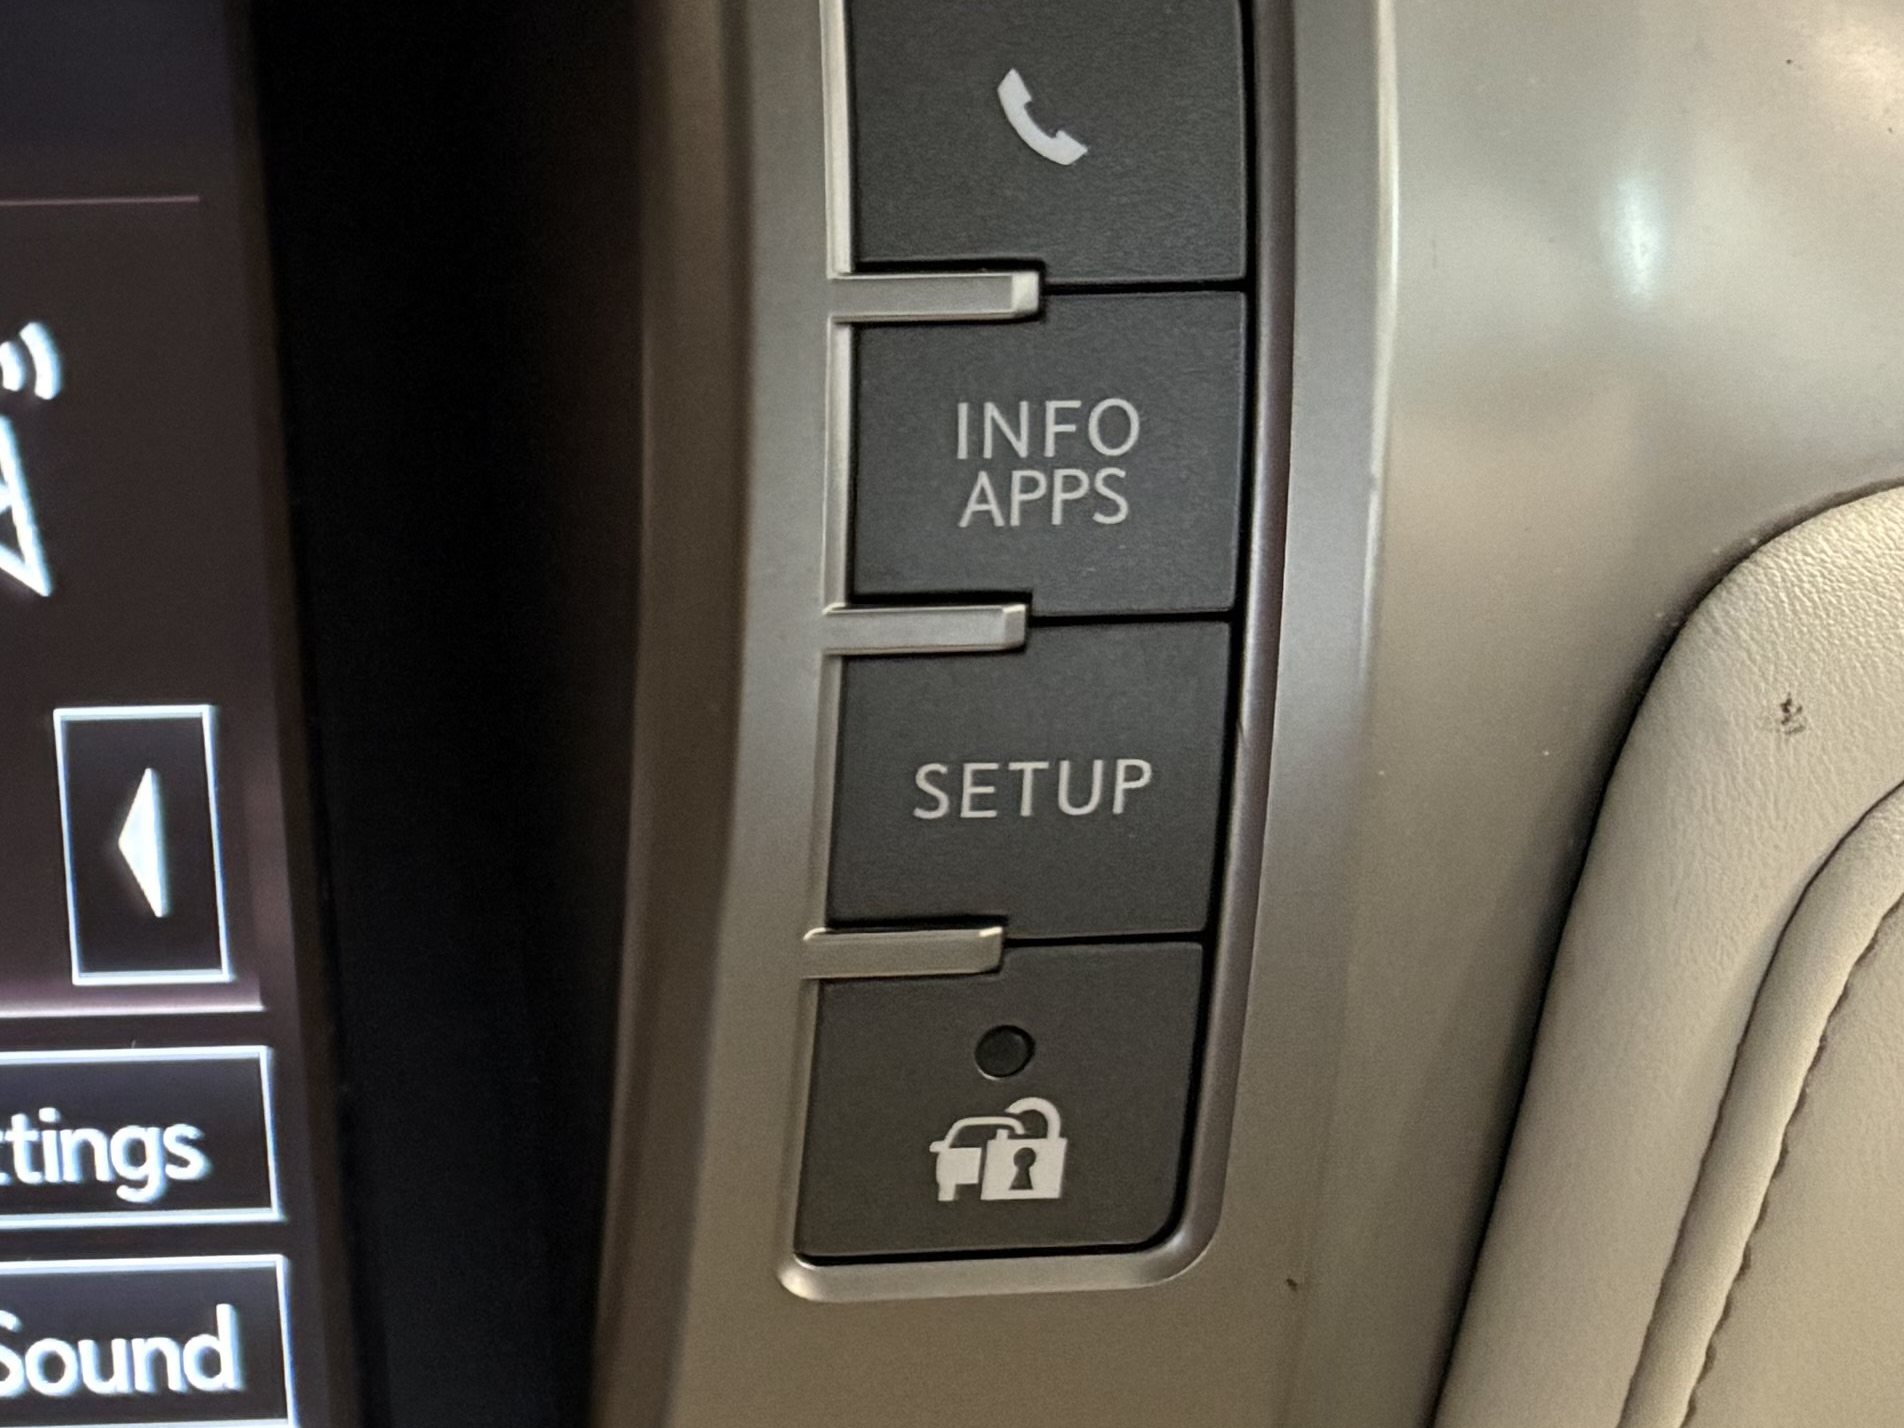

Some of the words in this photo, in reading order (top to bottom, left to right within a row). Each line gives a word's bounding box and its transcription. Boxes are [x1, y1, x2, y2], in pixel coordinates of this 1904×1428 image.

[956, 396, 1141, 461] INFO
[958, 465, 1130, 529] APPS
[913, 756, 1154, 821] SETUP
